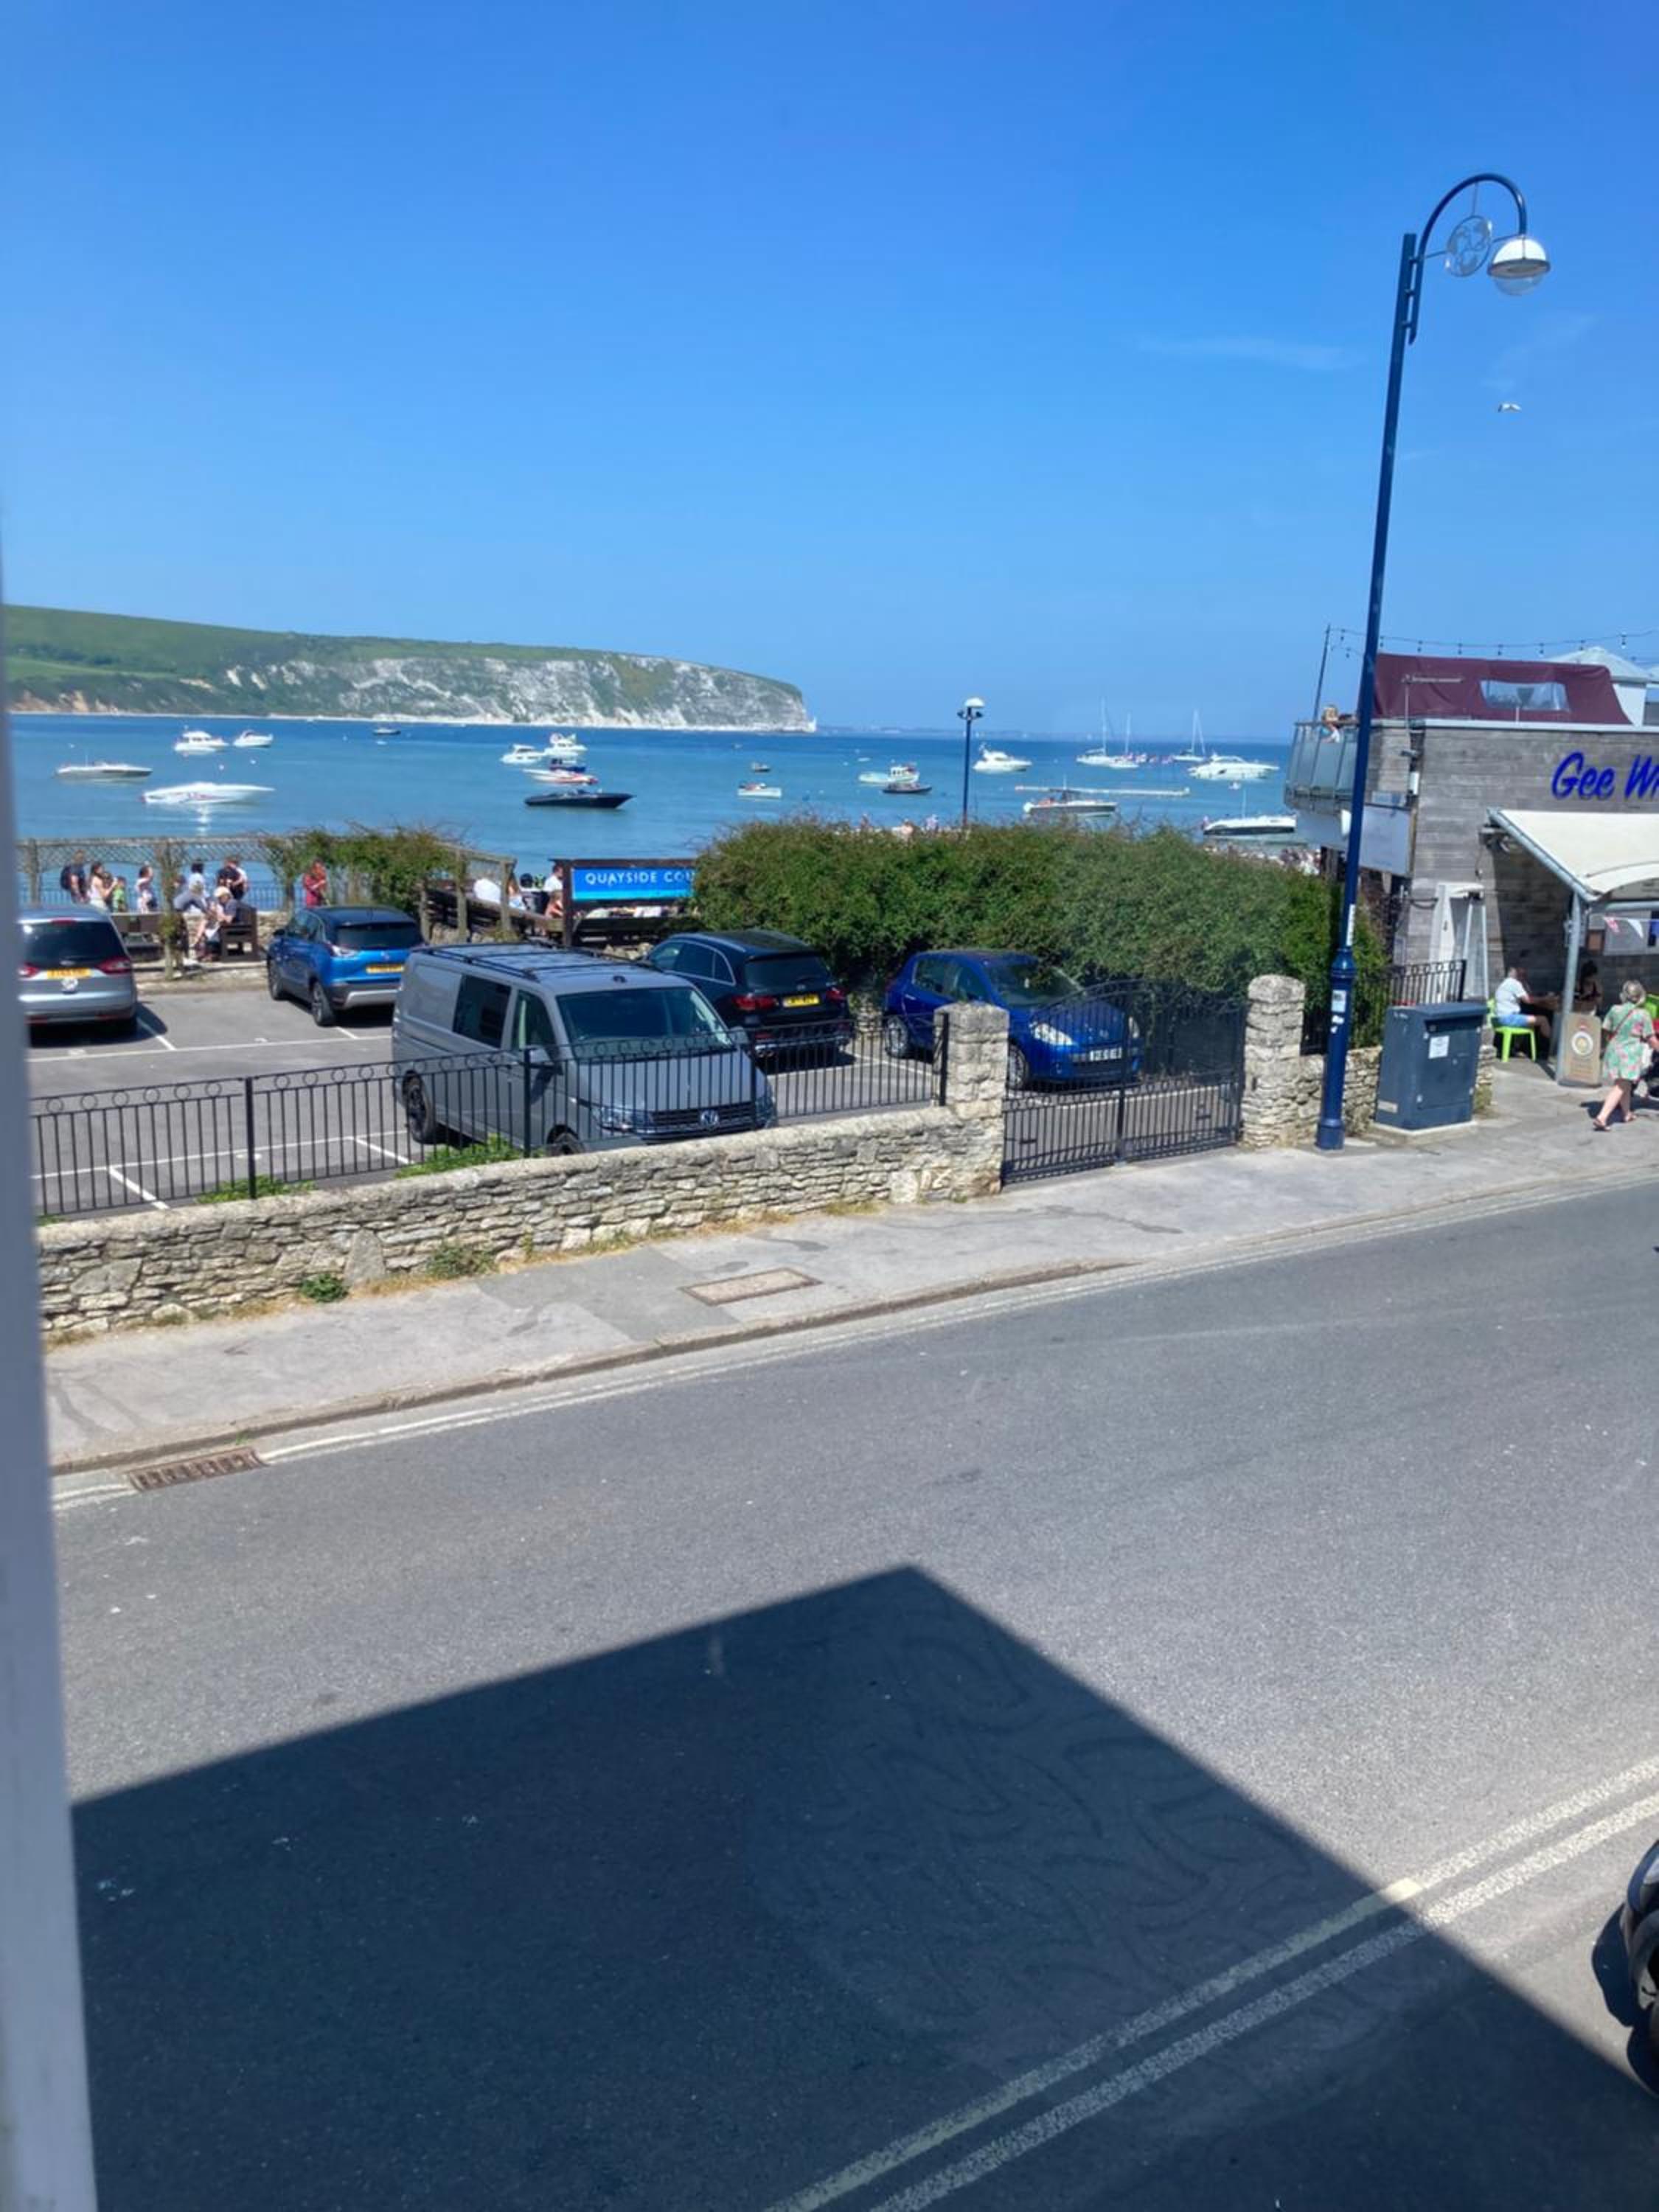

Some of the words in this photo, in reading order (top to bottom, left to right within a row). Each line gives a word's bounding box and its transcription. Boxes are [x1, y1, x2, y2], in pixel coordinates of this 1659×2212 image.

[1551, 751, 1615, 799] Gee
[1624, 754, 1659, 799] W
[585, 872, 658, 885] QUAYSIDE
